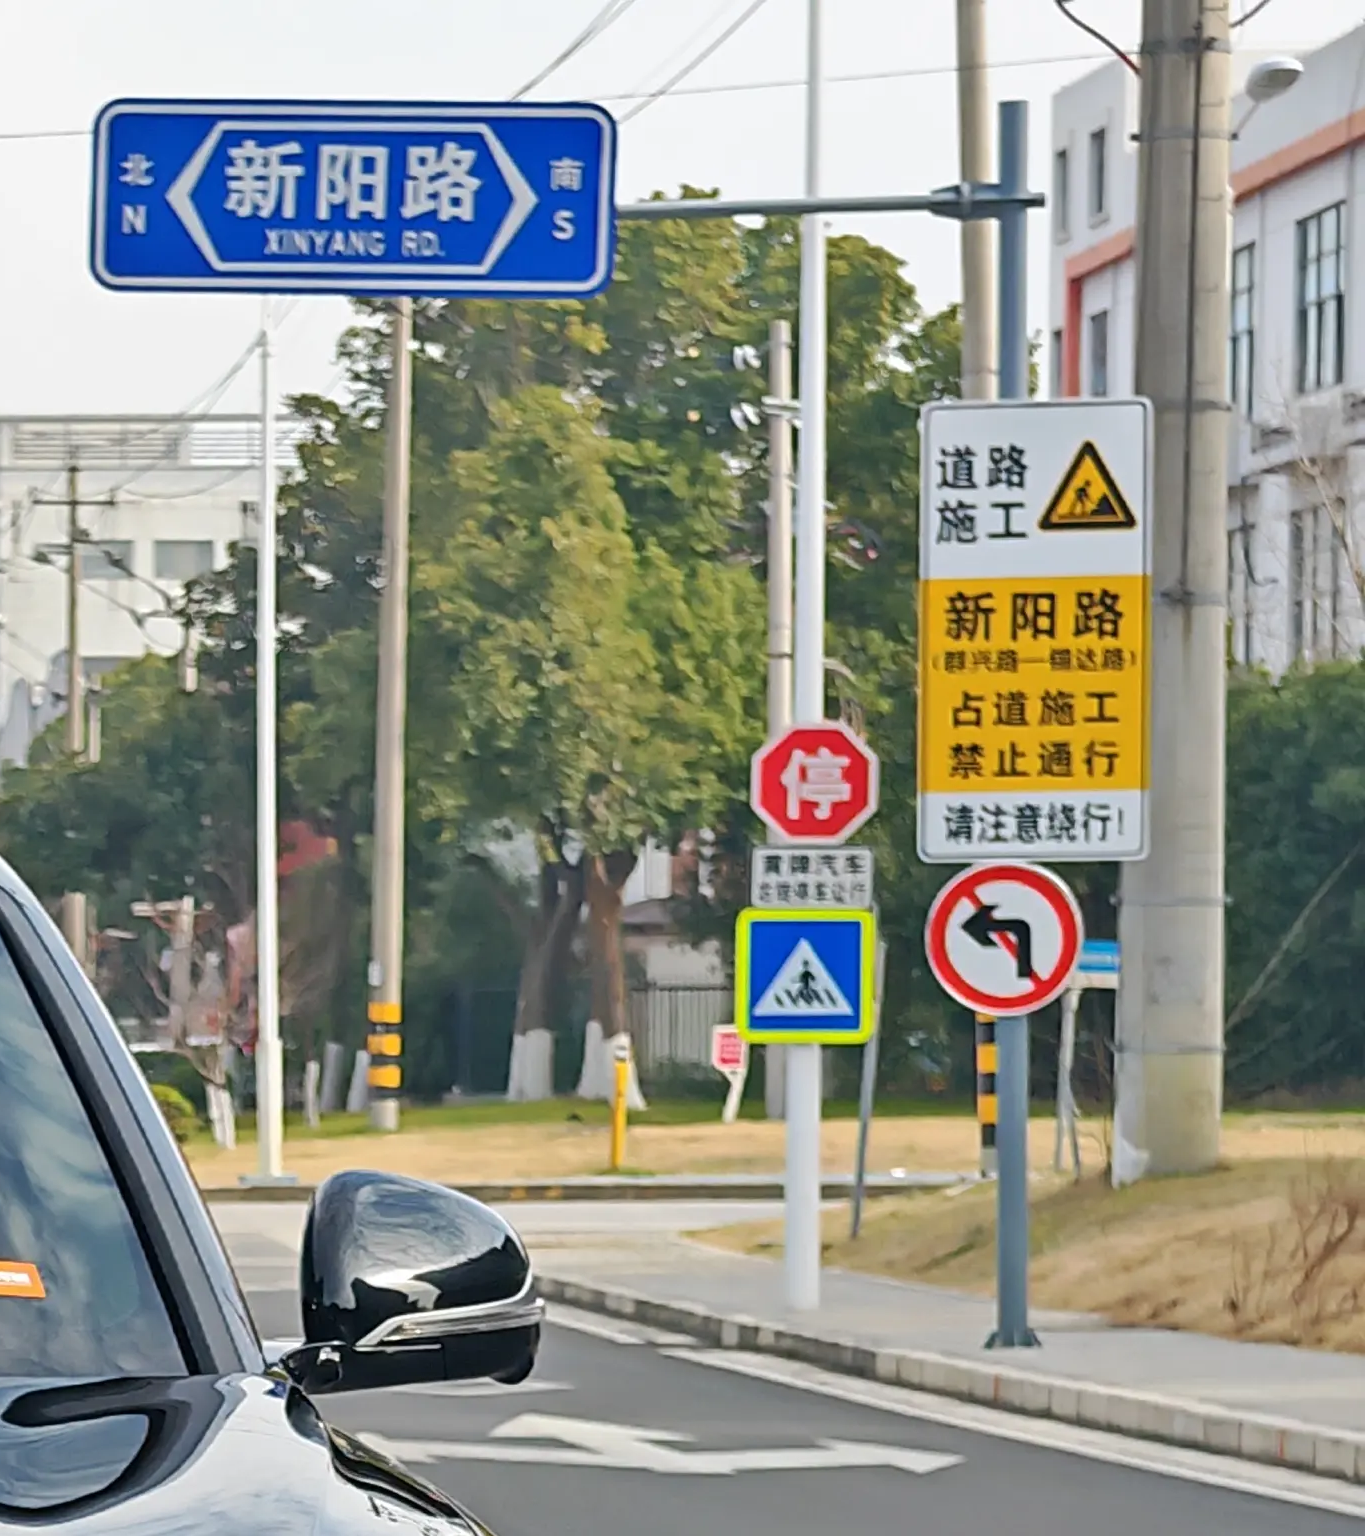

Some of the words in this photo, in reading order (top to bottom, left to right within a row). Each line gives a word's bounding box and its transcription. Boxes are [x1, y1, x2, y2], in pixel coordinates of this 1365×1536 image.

[119, 153, 155, 187] 北
[223, 140, 482, 222] 新阳路
[549, 158, 585, 192] 南
[120, 205, 147, 234] N
[551, 210, 576, 241] S
[264, 227, 386, 257] XINYANG
[936, 442, 1029, 491] 道路
[936, 501, 1029, 545] 施工
[943, 588, 1125, 642] 新阳路
[951, 688, 1121, 730] 占道施工
[948, 740, 1120, 780] 禁止通行
[781, 746, 852, 822] 停
